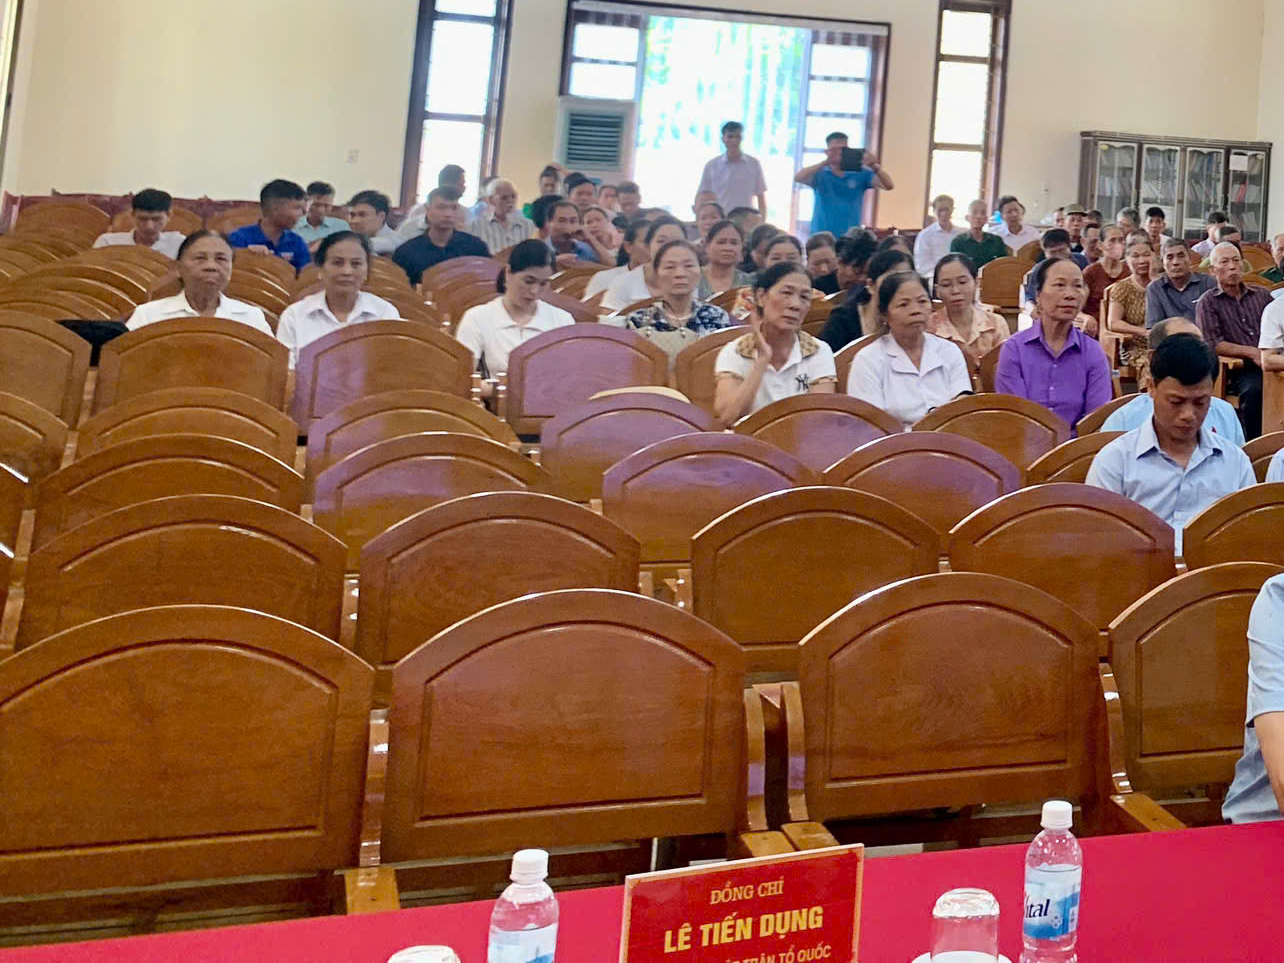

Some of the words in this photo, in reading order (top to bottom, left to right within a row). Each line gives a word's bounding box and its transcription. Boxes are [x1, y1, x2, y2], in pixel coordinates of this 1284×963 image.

[709, 880, 755, 905] ĐỒNG
[757, 875, 785, 898] CHÍ
[664, 922, 693, 954] LÊ
[699, 911, 753, 947] TIẾN
[759, 905, 824, 939] DỤNG
[778, 944, 796, 963] TỔ
[797, 941, 832, 962] QUỐC
